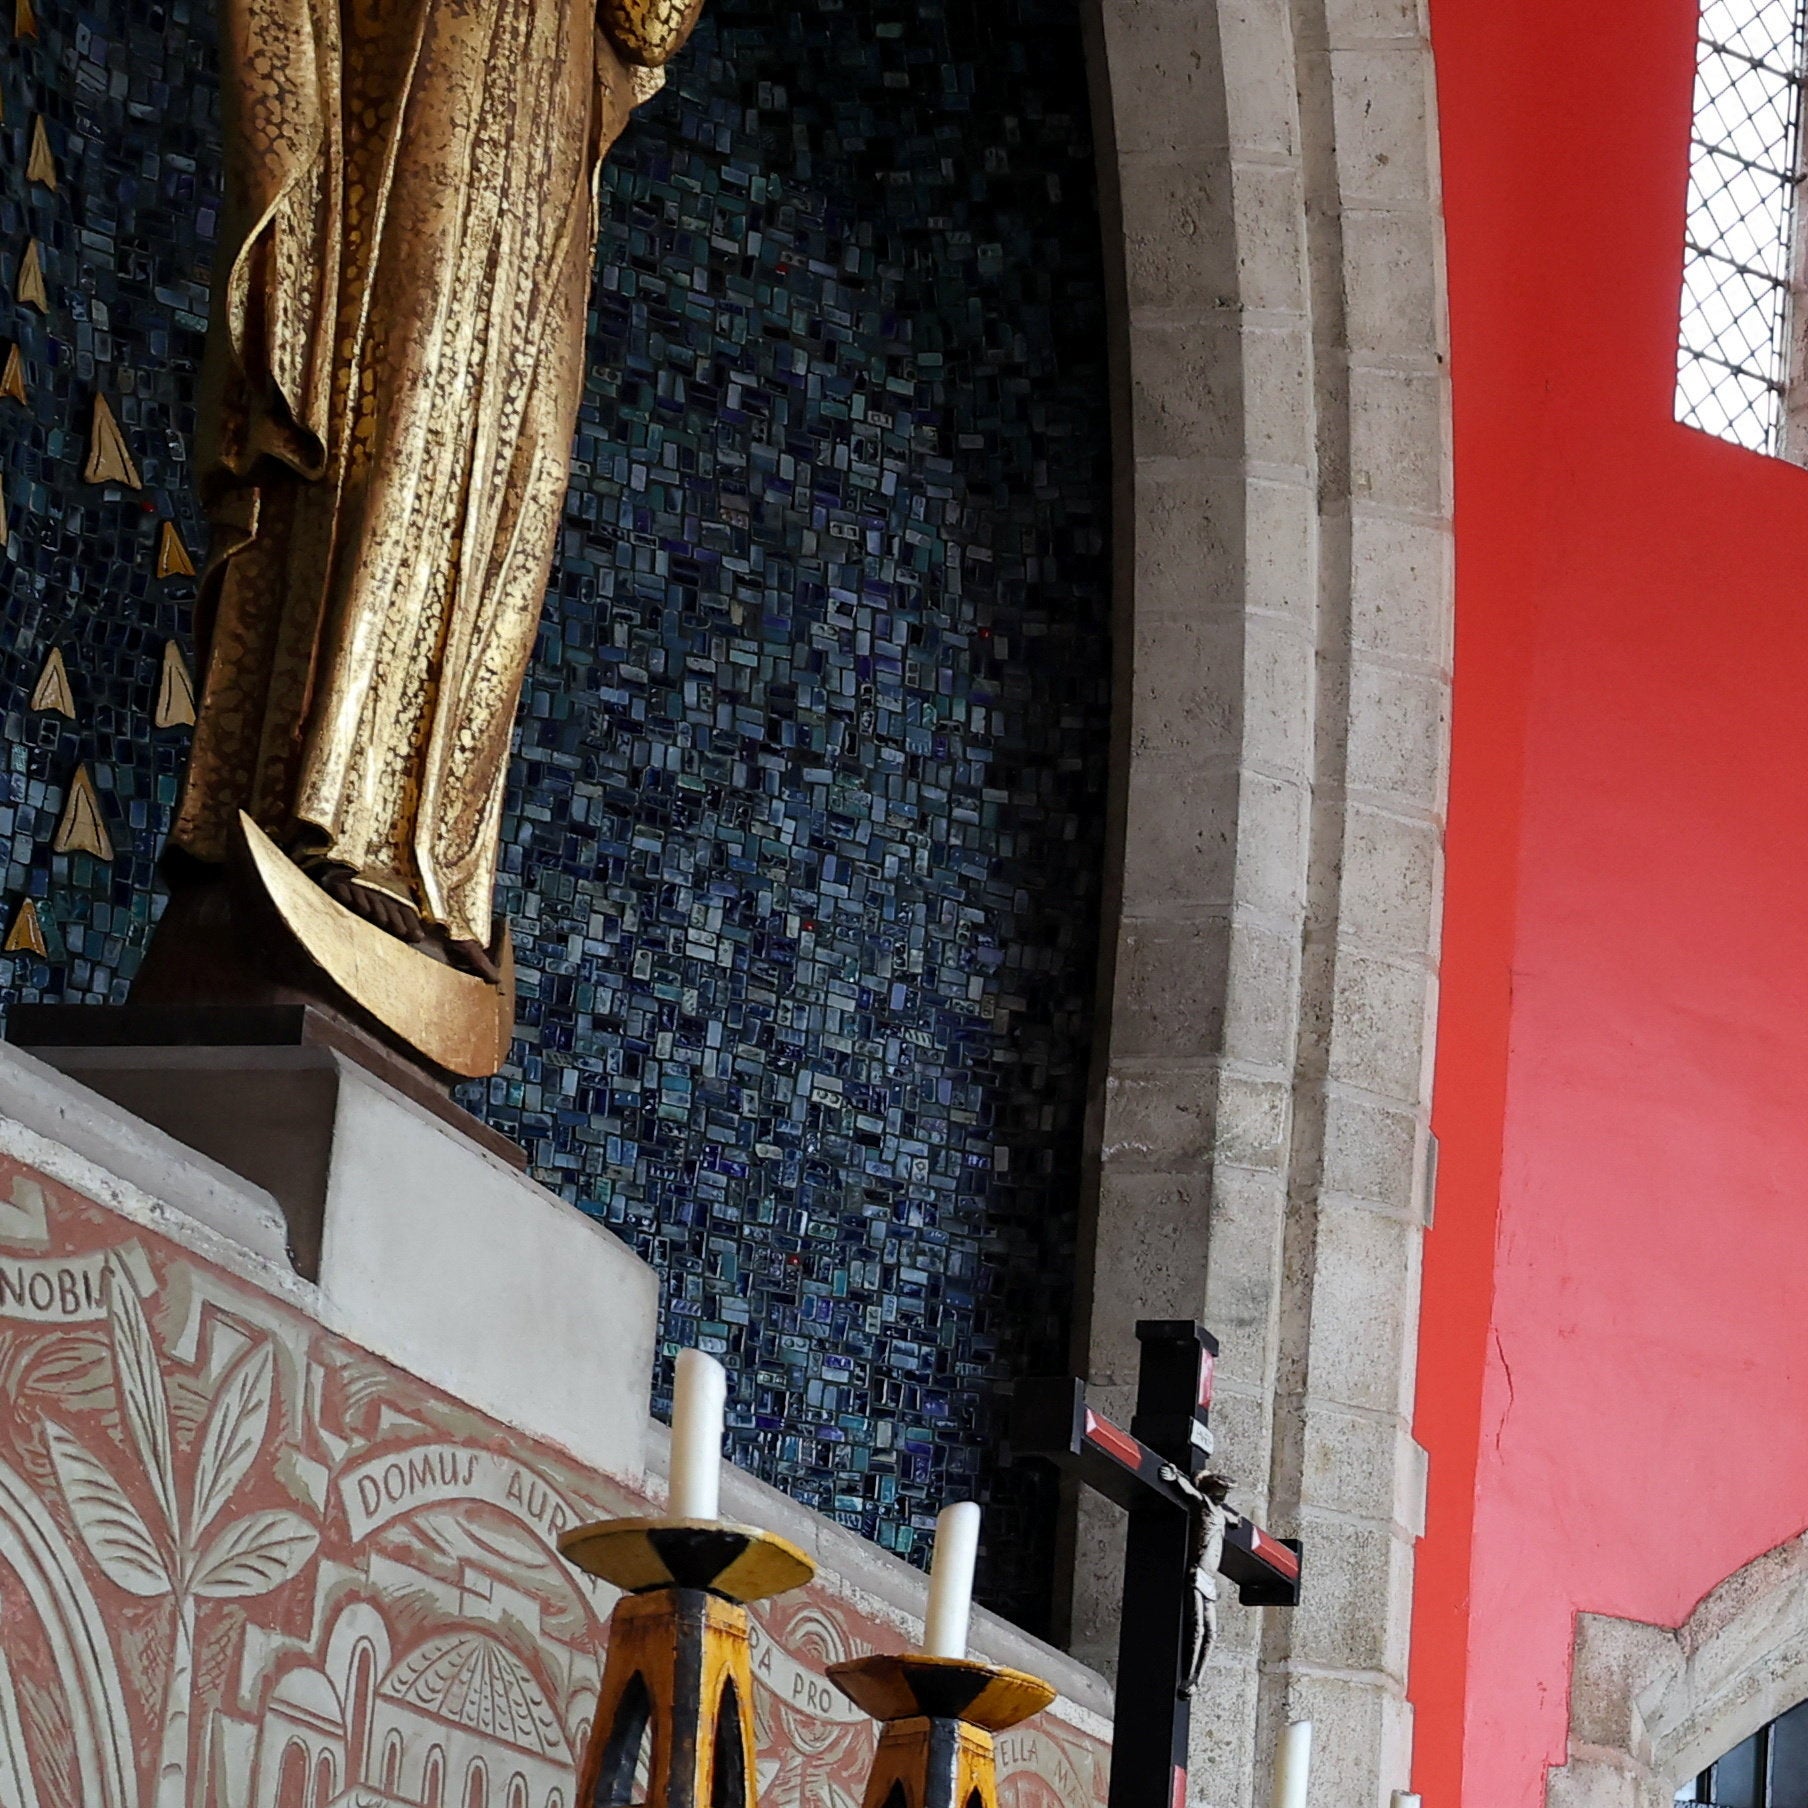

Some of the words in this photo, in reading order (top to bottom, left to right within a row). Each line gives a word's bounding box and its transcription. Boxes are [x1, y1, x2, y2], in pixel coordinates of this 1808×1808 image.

[0, 1266, 116, 1314] NOBIS
[357, 1451, 479, 1519] DOMUS
[793, 1671, 832, 1714] PRO
